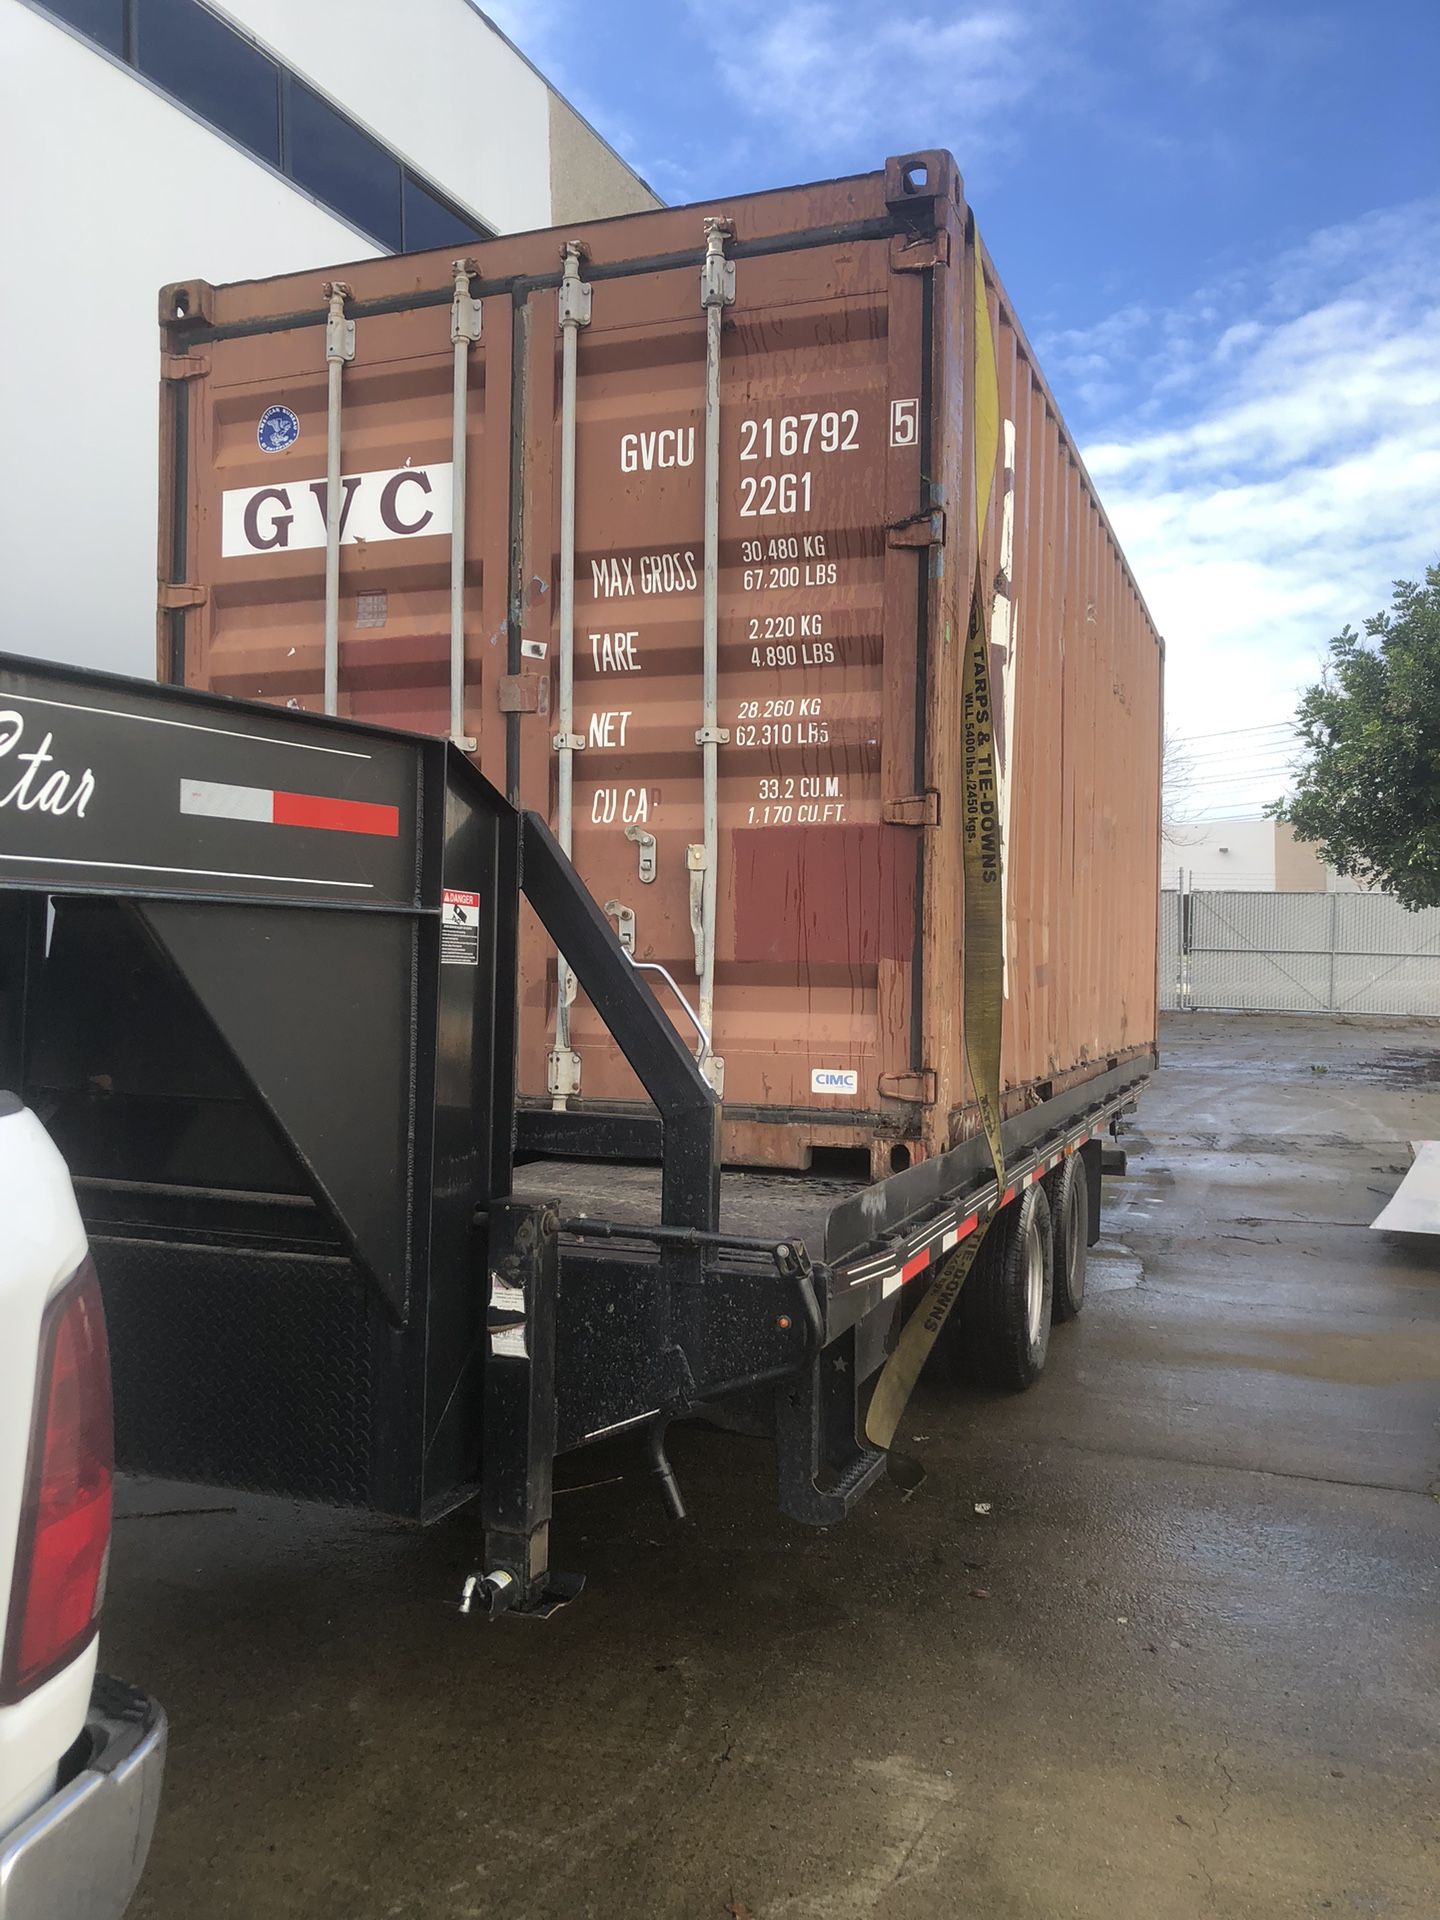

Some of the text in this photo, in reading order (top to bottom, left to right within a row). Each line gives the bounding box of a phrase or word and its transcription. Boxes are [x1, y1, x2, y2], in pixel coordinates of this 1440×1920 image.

[620, 401, 915, 473] GVCU 216792 5
[739, 472, 812, 517] 22G1
[243, 470, 434, 551] GVC
[803, 535, 826, 558] KG
[591, 551, 698, 599] MAX GROSS
[804, 563, 837, 586] LBS
[800, 614, 822, 636] KG
[589, 631, 642, 673] TARE
[802, 642, 835, 665] LBS
[973, 646, 989, 722] TARPS
[799, 698, 822, 716] KG
[964, 692, 974, 720] WLL
[589, 711, 632, 748] NET
[797, 722, 829, 745] LBS
[965, 722, 975, 755] 5400
[977, 730, 991, 747] &
[759, 776, 844, 800] 33.2 CU.M.
[591, 788, 617, 824] CU
[797, 803, 847, 823] CU.FT.
[977, 753, 997, 884] TIE-DOWNS
[965, 817, 978, 844] kgs.
[449, 892, 474, 905] DANGER
[815, 1073, 854, 1086] CIMC
